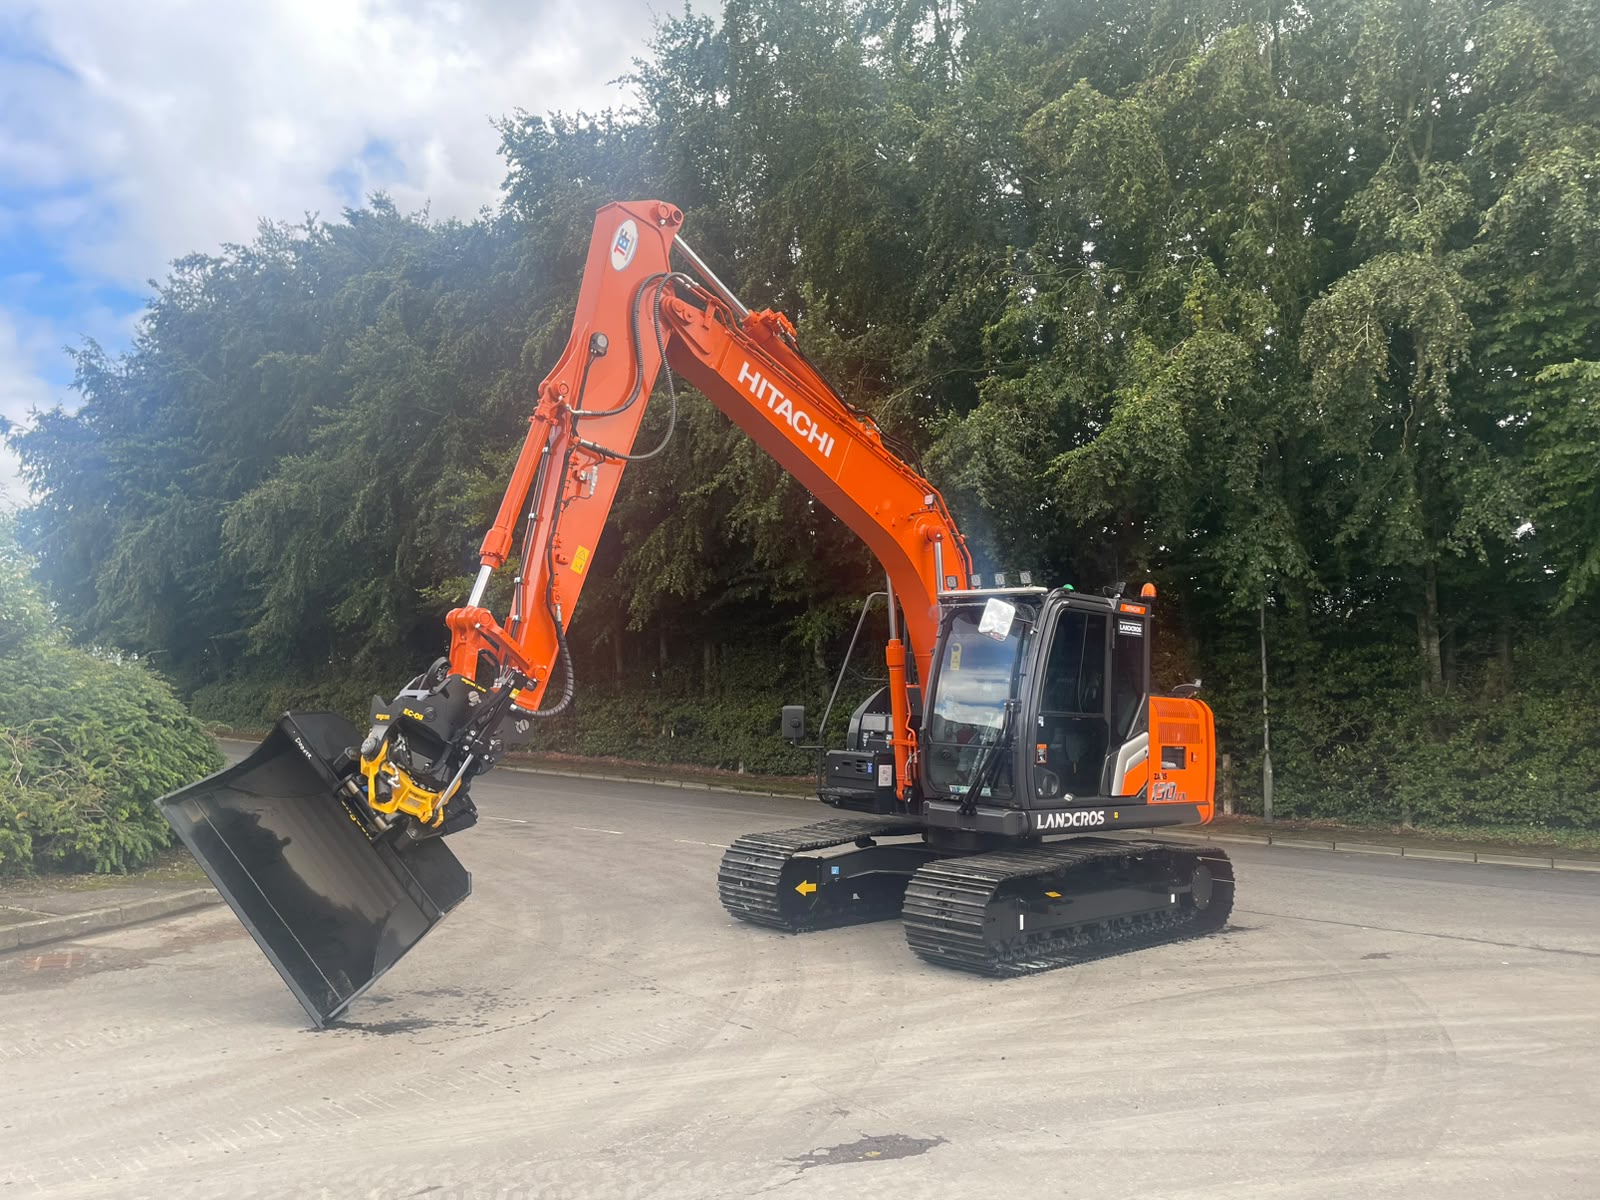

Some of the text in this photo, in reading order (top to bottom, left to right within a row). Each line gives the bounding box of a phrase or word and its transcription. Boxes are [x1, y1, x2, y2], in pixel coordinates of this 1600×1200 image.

[614, 228, 630, 256] TBF
[737, 361, 835, 458] HITACHI
[1036, 811, 1105, 830] LANDCROS
